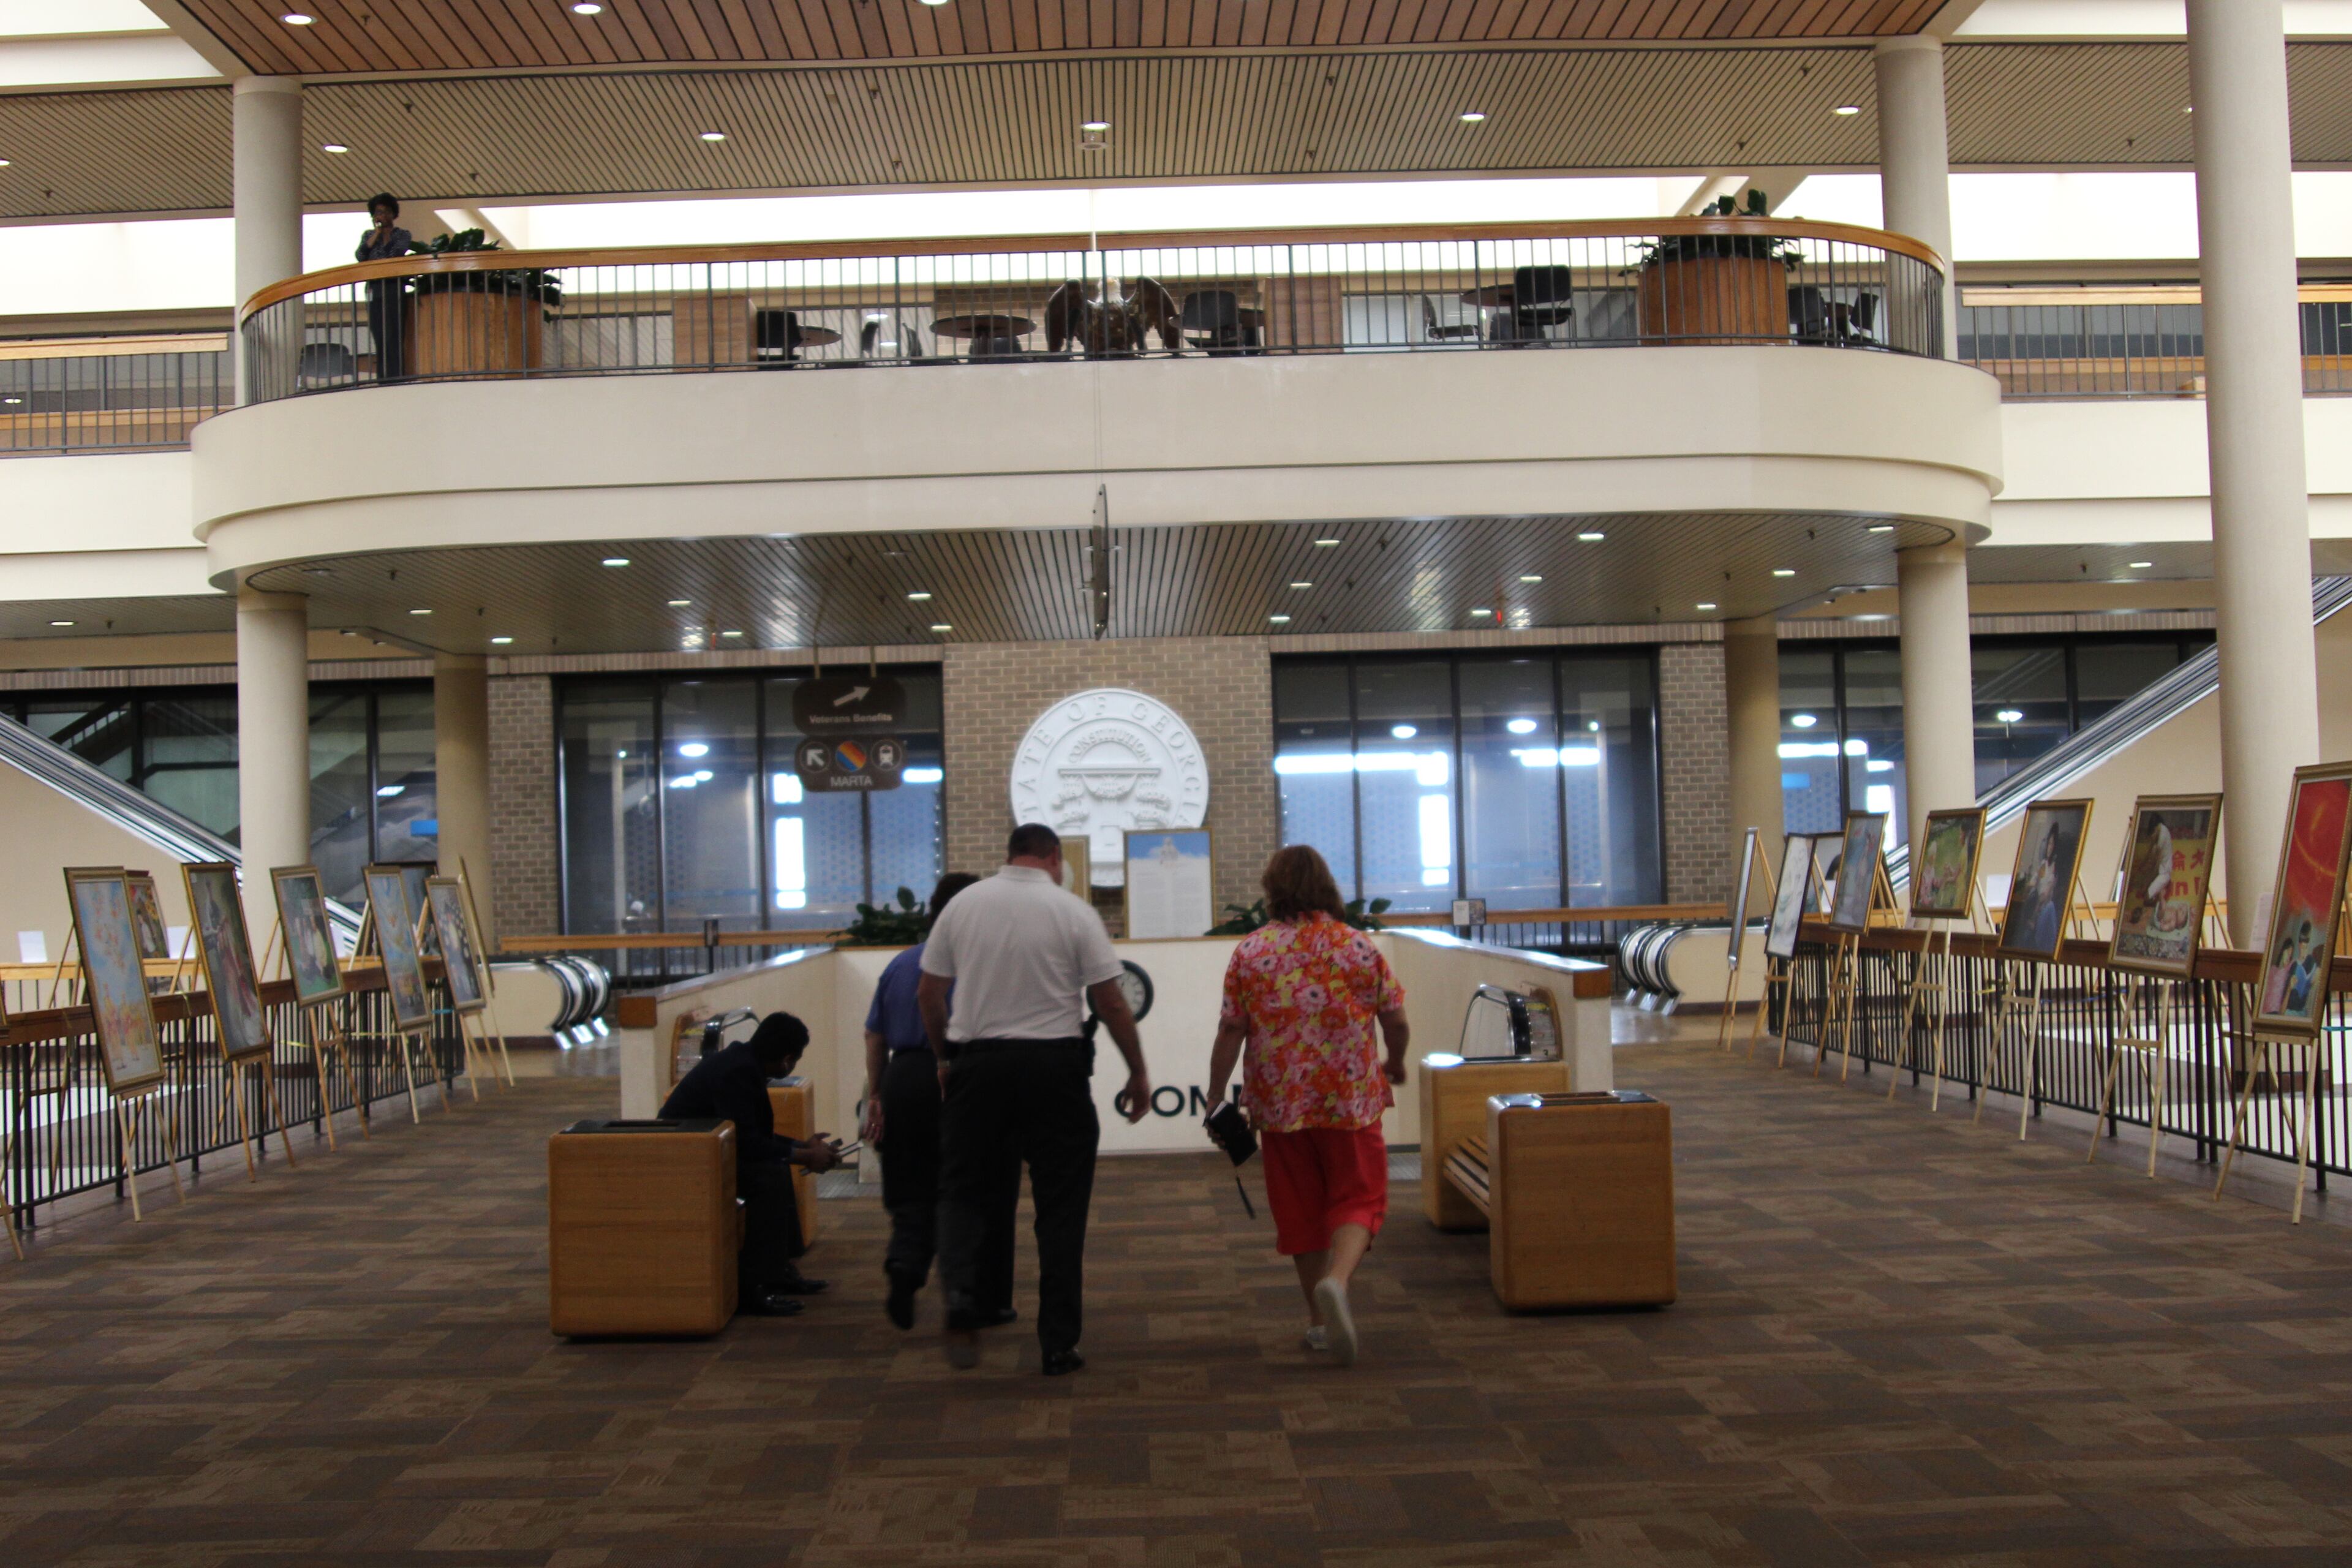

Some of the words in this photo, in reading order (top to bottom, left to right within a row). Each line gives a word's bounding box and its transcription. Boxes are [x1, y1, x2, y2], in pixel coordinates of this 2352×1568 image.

[810, 715, 850, 723] Veterans
[853, 713, 892, 723] Benefits
[1068, 695, 1107, 722] OF
[1068, 727, 1152, 764] CONSTITUTION
[831, 775, 873, 787] MARTA
